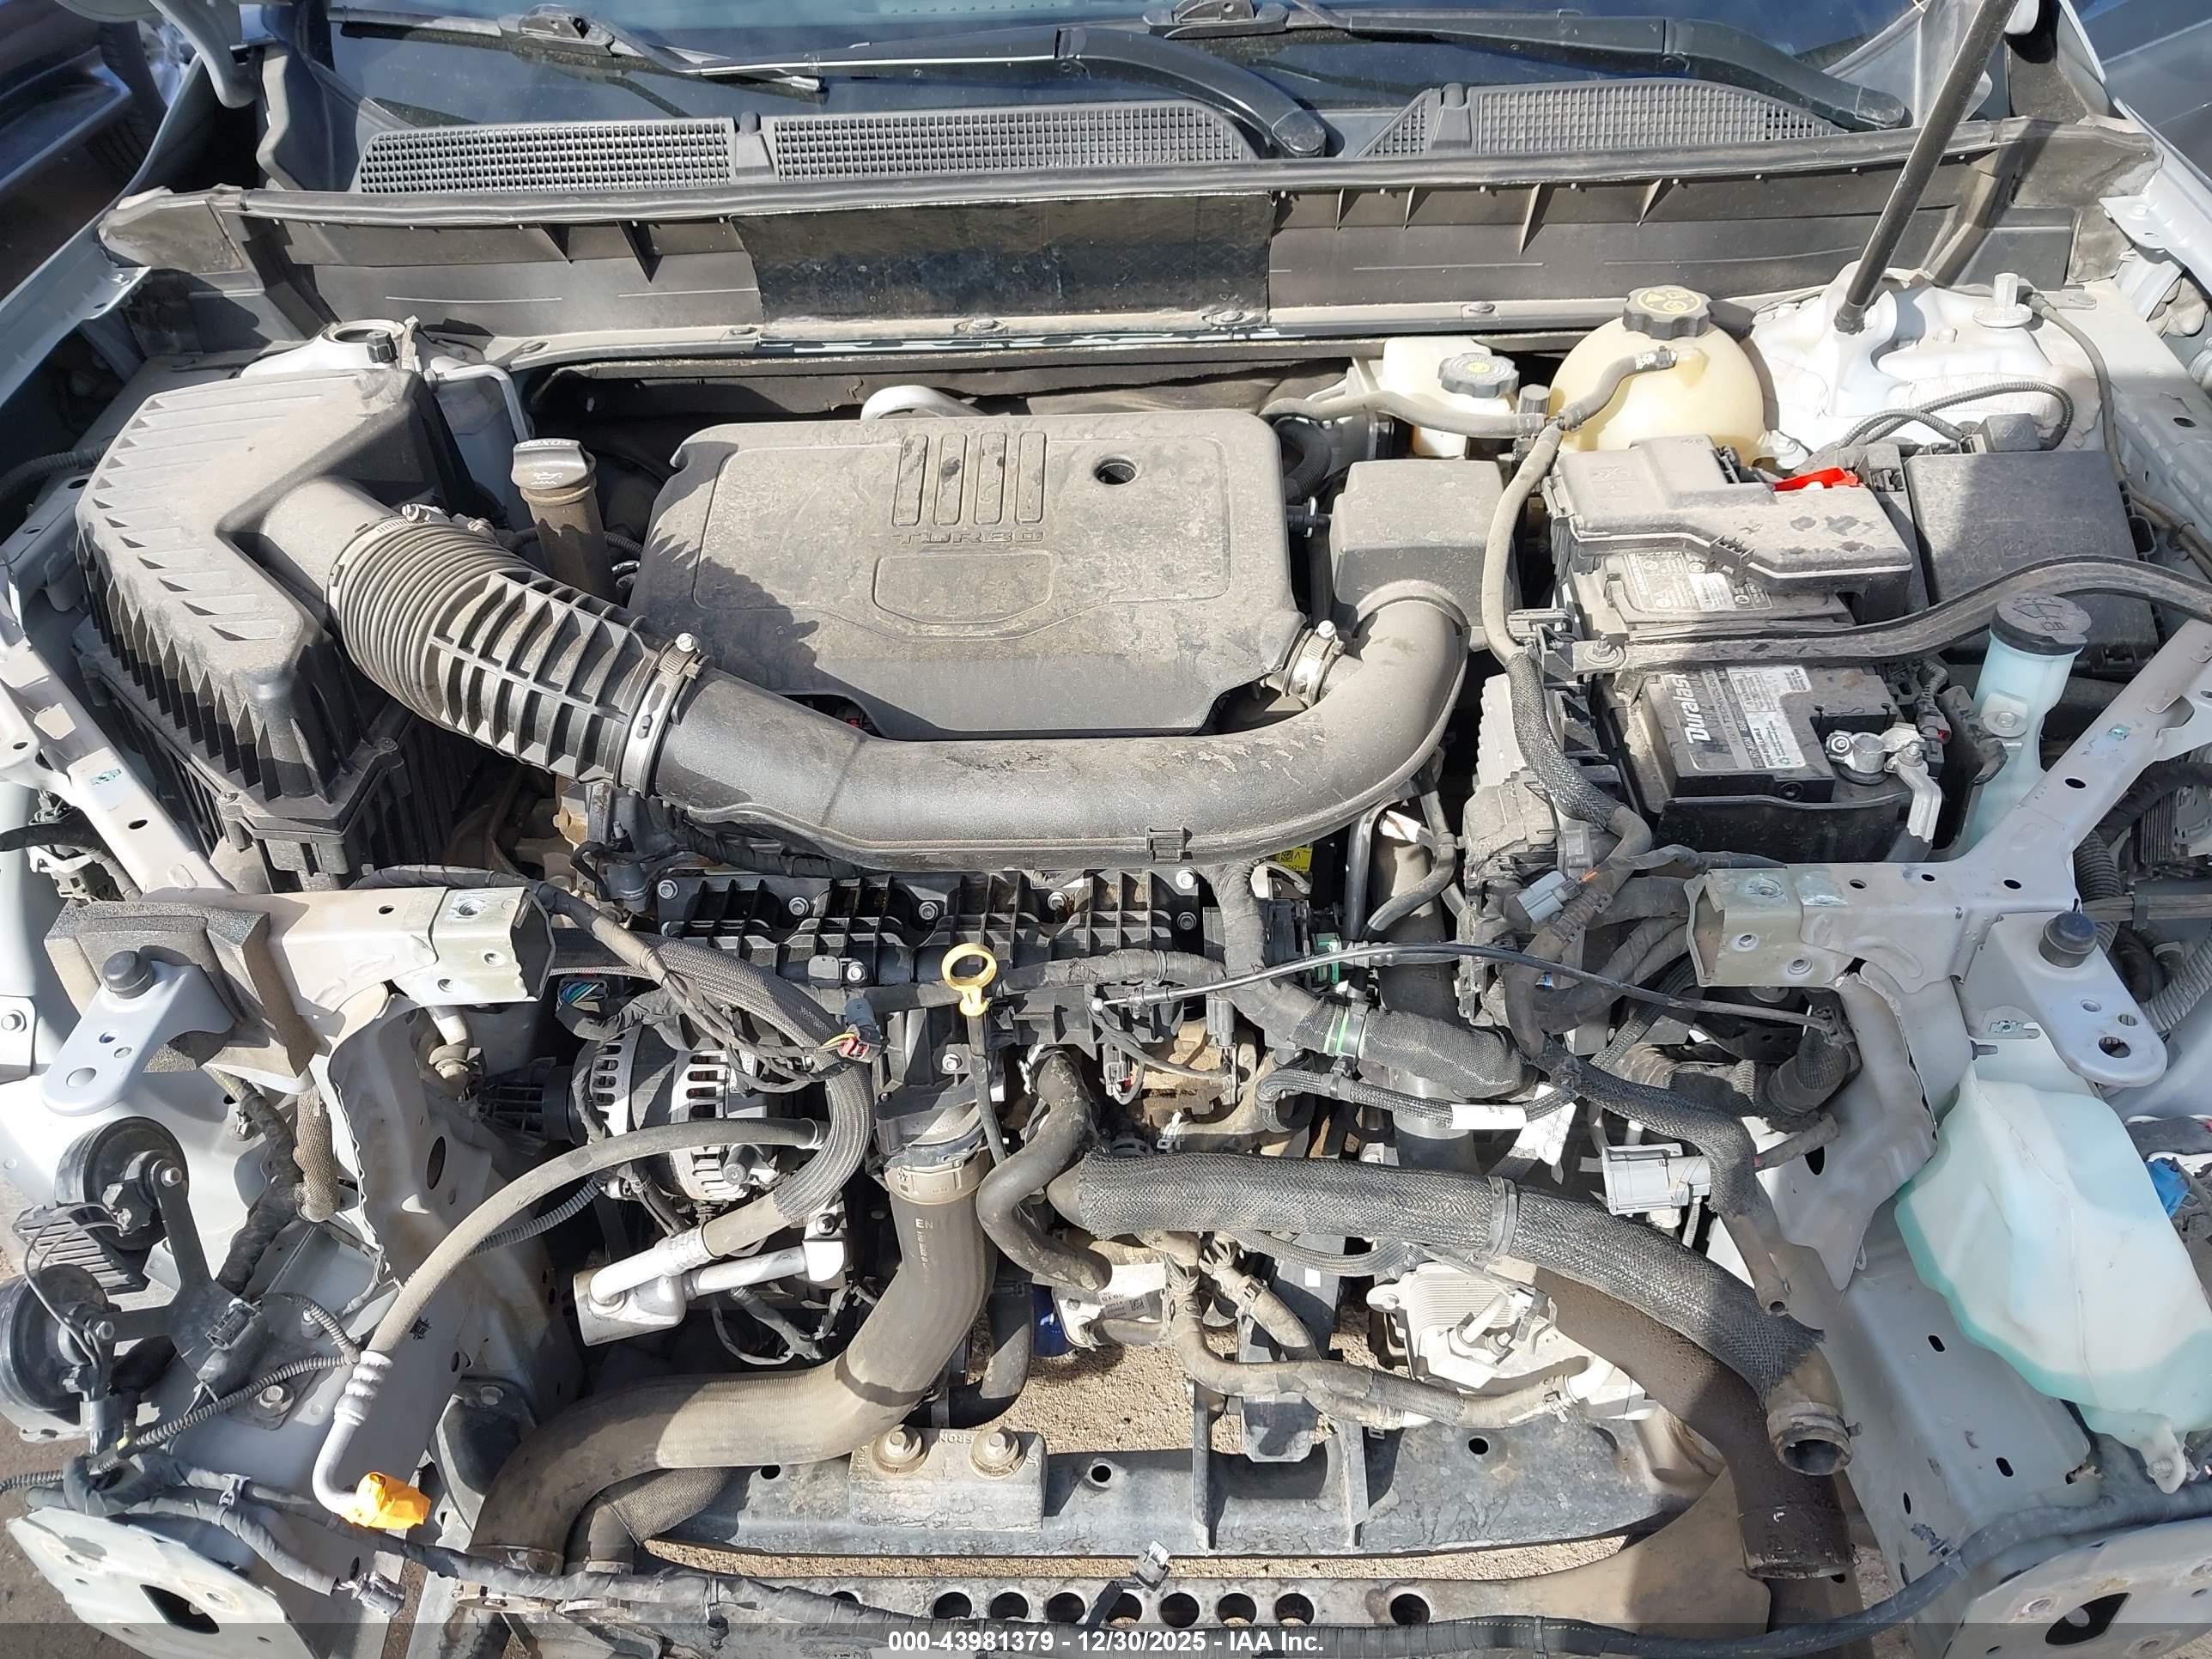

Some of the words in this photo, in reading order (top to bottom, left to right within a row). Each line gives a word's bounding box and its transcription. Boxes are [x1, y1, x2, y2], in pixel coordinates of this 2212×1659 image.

[520, 440, 571, 448] dexos
[892, 531, 1045, 545] TURBO
[1668, 673, 1711, 744] Duralast
